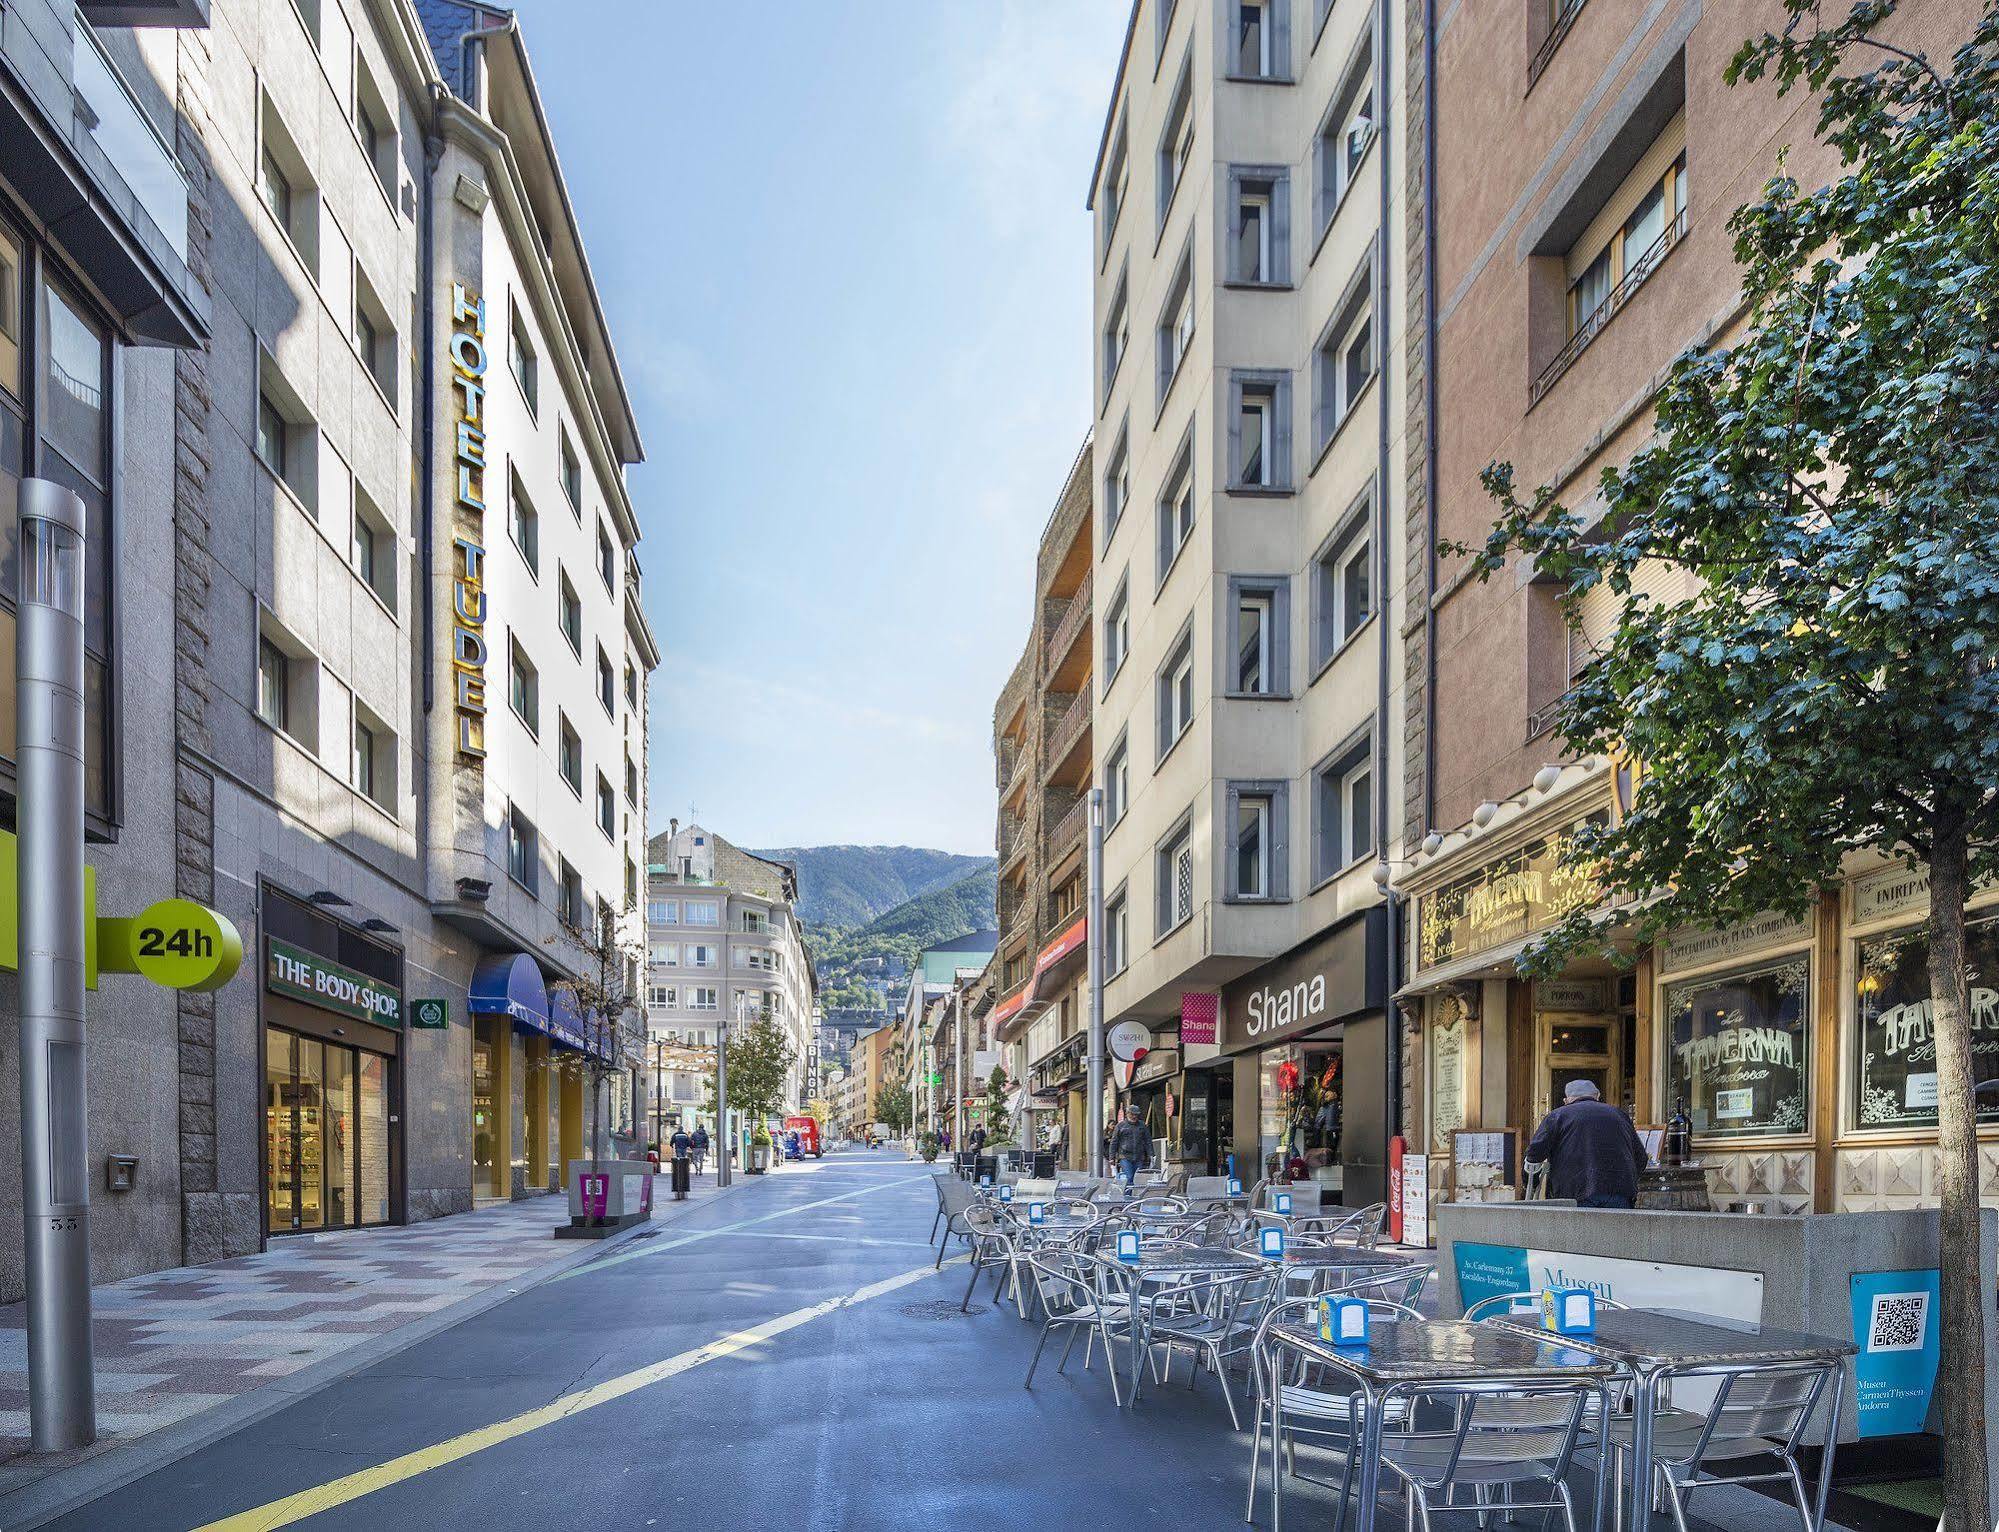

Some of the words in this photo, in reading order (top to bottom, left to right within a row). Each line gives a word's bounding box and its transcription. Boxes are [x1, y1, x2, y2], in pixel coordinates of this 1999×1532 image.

[450, 281, 487, 511] HOTEL
[453, 537, 488, 759] TUDEL
[1466, 870, 1543, 930] TAVERNA
[1876, 876, 1932, 905] ENTREPAN
[139, 927, 212, 957] 24h
[1732, 926, 1755, 942] PLATS
[1757, 914, 1797, 935] COMBINA
[274, 953, 311, 988] THE
[315, 969, 360, 1004] BODY
[1247, 973, 1326, 1037] Shana
[1182, 1019, 1215, 1031] Shana
[1678, 1026, 1794, 1080] TAVERNA
[808, 1046, 817, 1097] BINGO
[1461, 1270, 1520, 1289] Escaldes-Engordany
[1473, 1261, 1505, 1275] Carlemany
[1505, 1266, 1514, 1275] 37
[1858, 1380, 1886, 1390] Museu
[1858, 1400, 1890, 1411] Andorra
